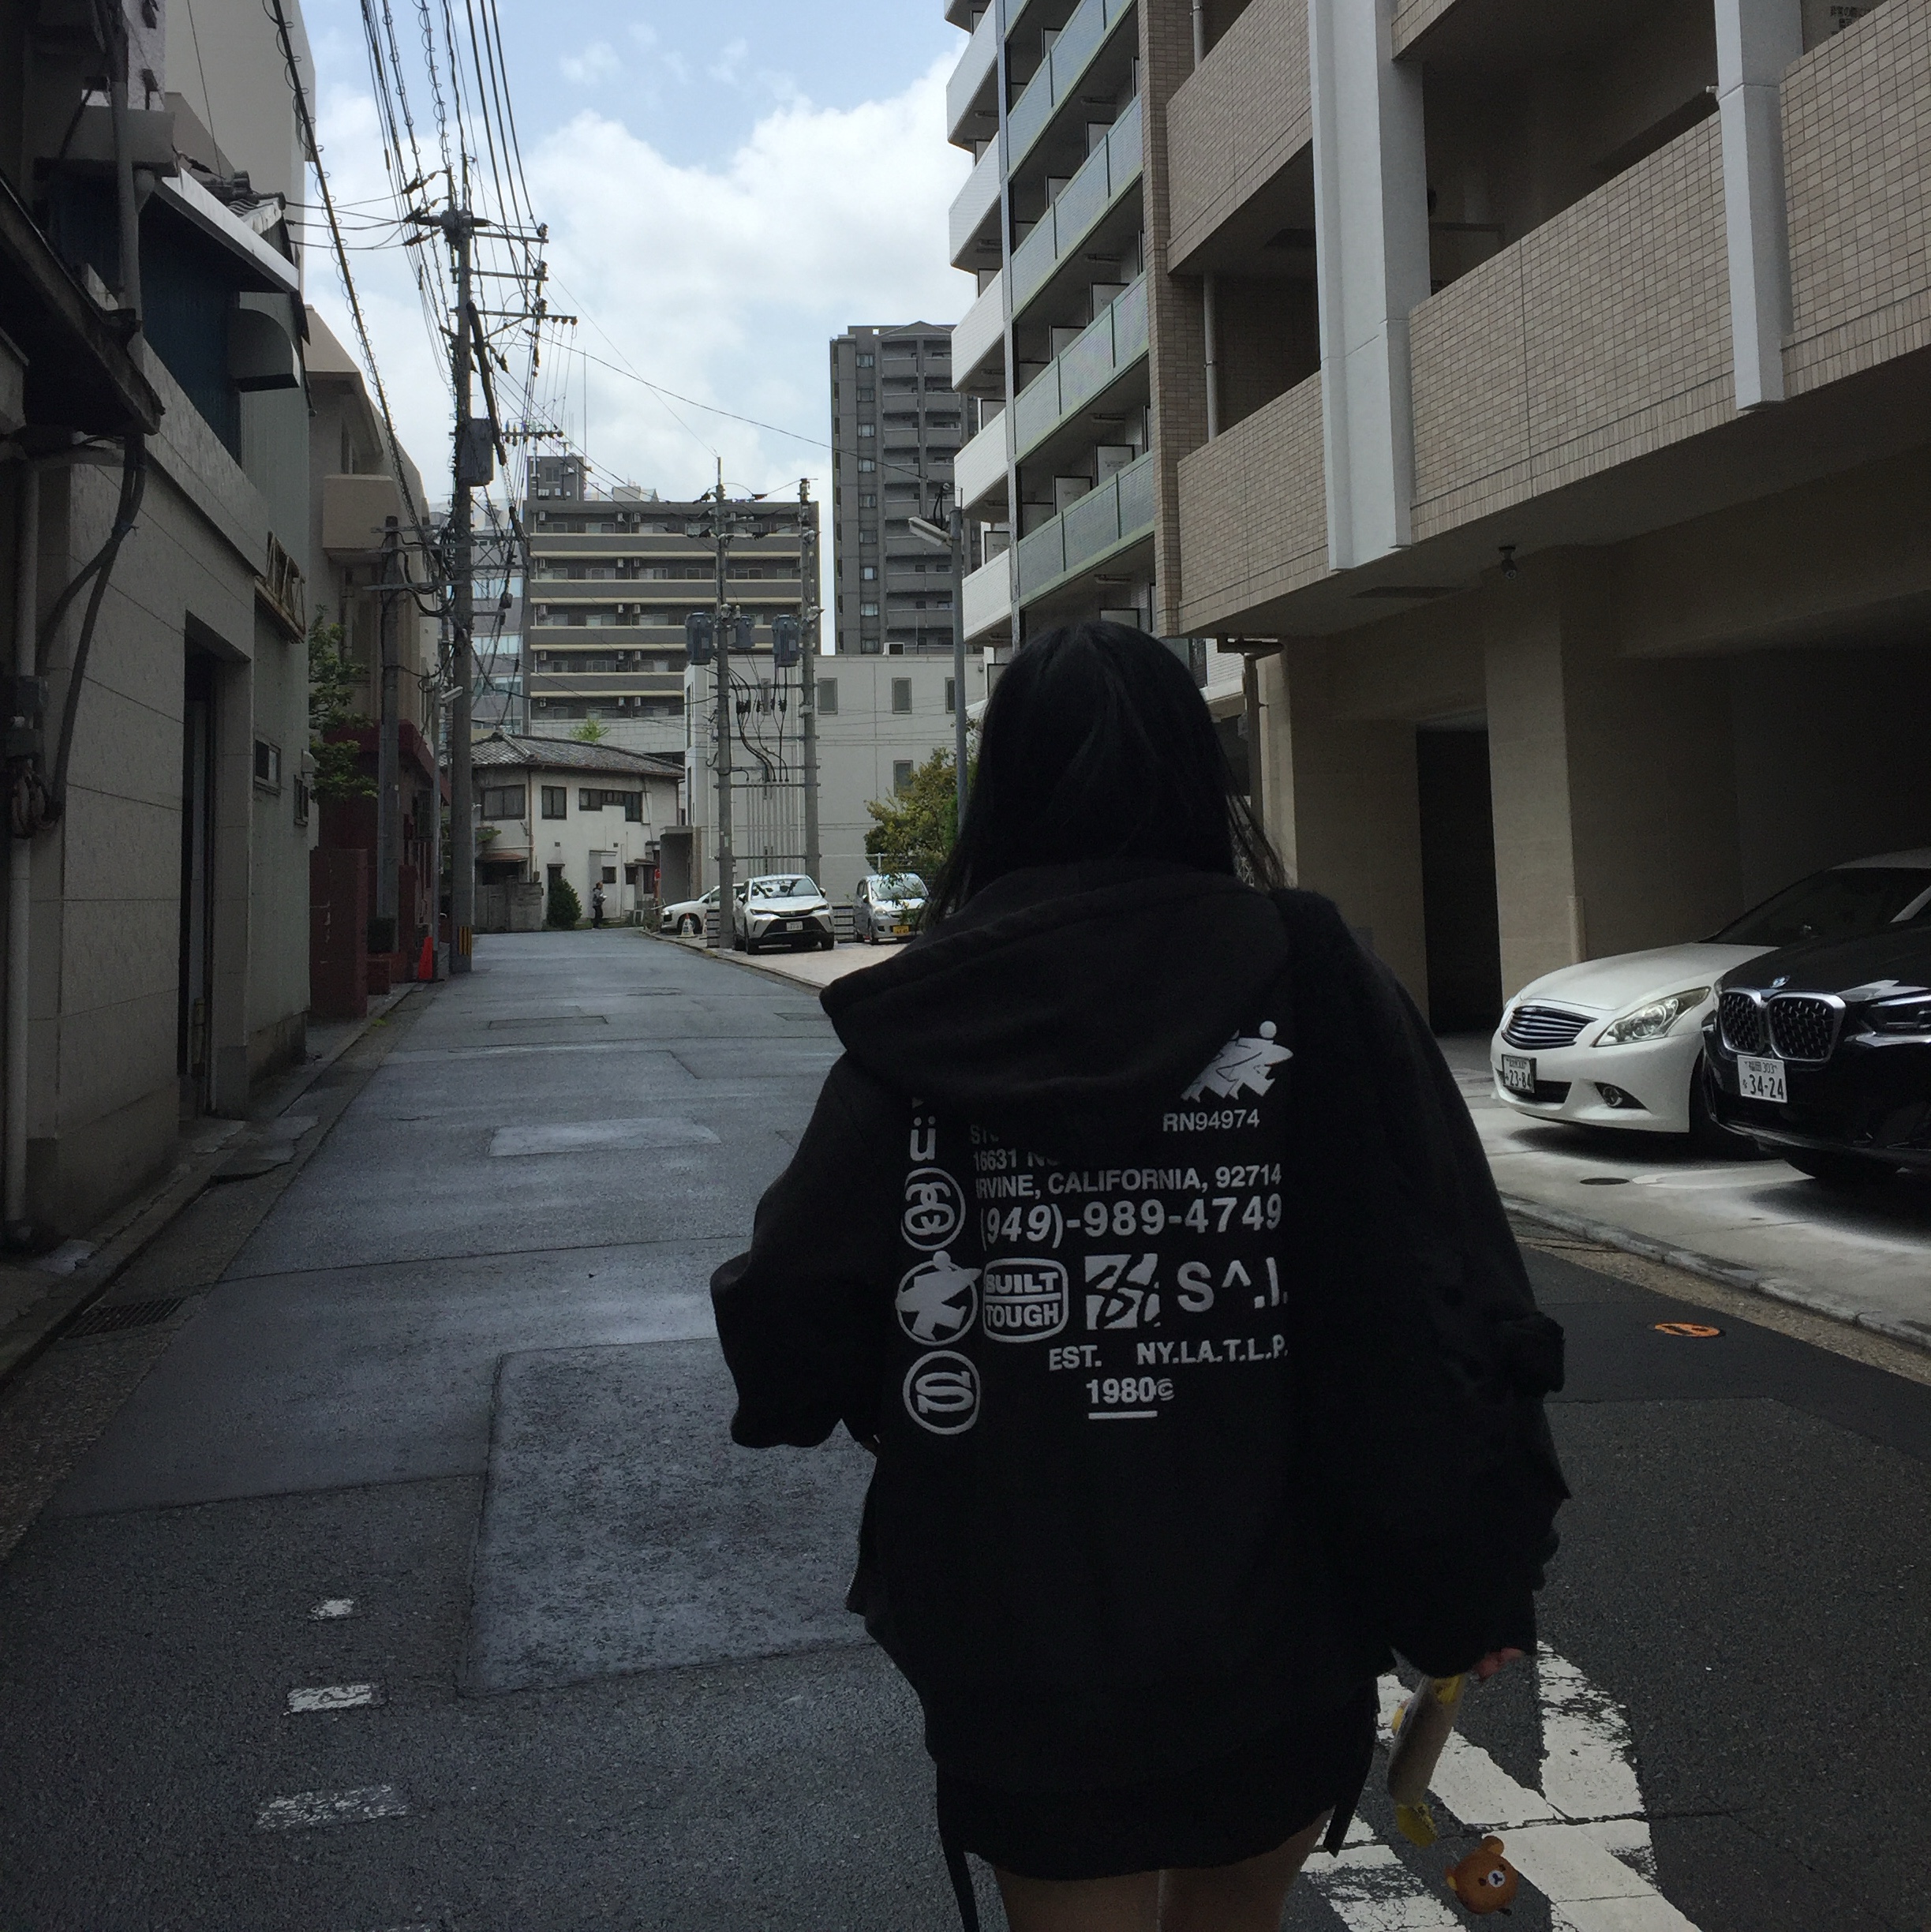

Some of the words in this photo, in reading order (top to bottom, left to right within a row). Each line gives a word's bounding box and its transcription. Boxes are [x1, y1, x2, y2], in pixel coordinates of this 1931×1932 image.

[1162, 1108, 1260, 1132] RN94974
[974, 1149, 1016, 1170] 16631
[976, 1174, 1041, 1200] IRVINE,
[1048, 1168, 1207, 1194] CALIFORNIA,
[1215, 1164, 1281, 1188] 92714
[980, 1193, 1282, 1252] (949)-989-4749
[986, 1271, 1058, 1294] BUILT
[986, 1303, 1059, 1327] TOUGH
[1050, 1345, 1102, 1370] EST.
